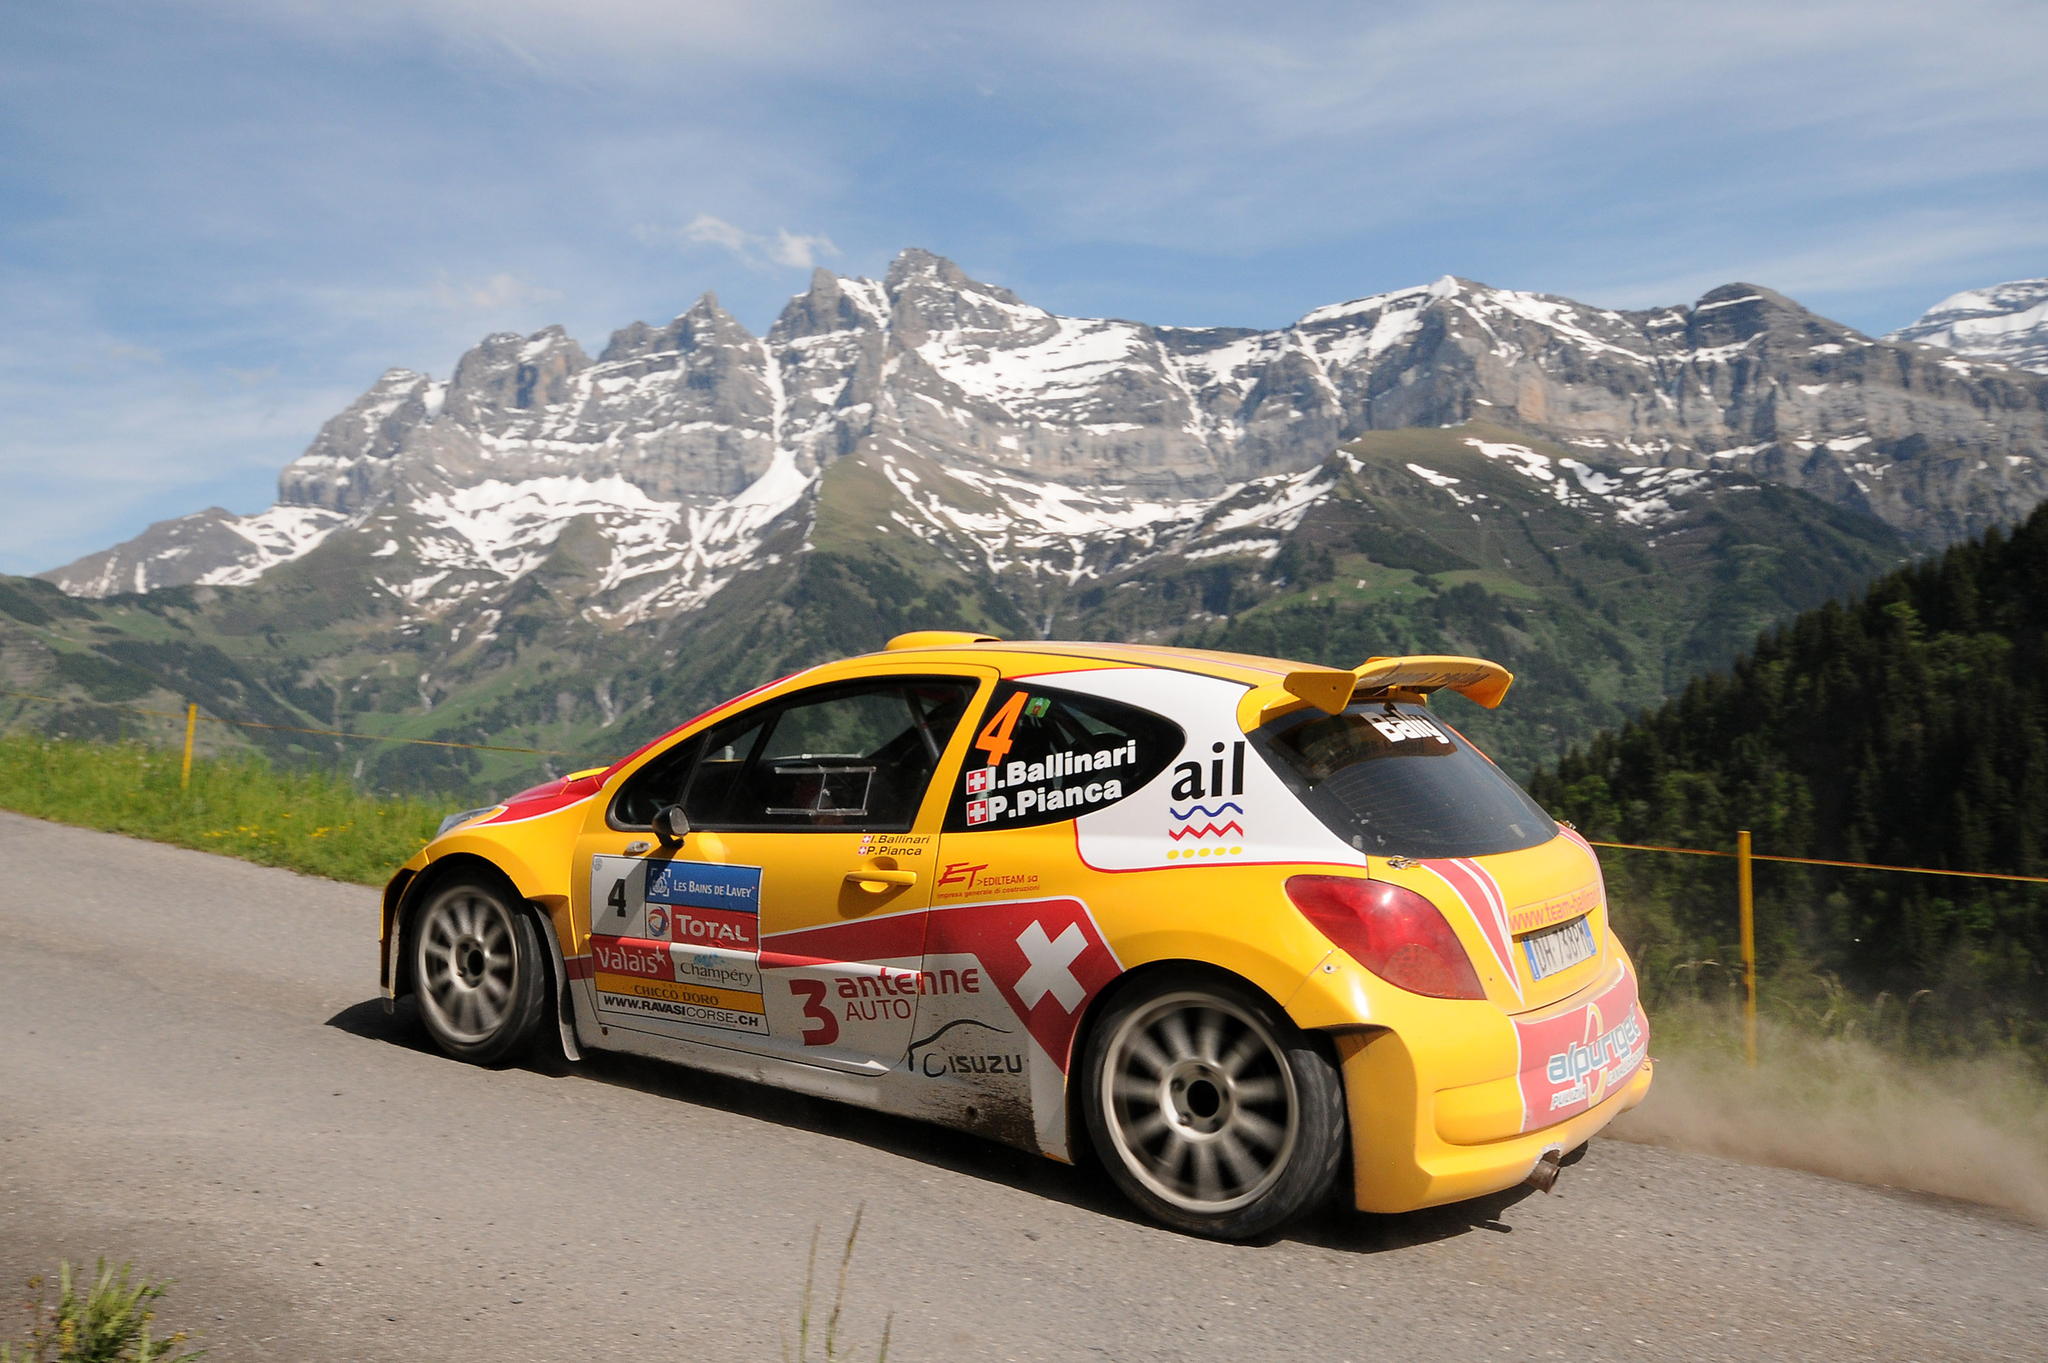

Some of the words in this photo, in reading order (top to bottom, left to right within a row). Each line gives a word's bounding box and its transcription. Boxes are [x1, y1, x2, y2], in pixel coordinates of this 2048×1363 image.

[975, 692, 1029, 766] 4
[1360, 709, 1450, 744] Bally
[988, 740, 1137, 791] I.Ballinari
[1170, 741, 1246, 801] ail
[988, 780, 1122, 822] P.Pianca
[866, 846, 922, 855] P.Pianca
[870, 835, 931, 844] I.Ballinari
[938, 862, 989, 890] ET
[1027, 875, 1038, 883] sa
[608, 879, 627, 917] 4
[964, 888, 993, 898] generale
[1002, 885, 1040, 894] costruzioni
[596, 947, 659, 974] Valais
[680, 962, 753, 987] Champéry
[634, 984, 679, 1000] CHICCO
[603, 995, 759, 1027] WWW.RAVASICORSE.CH
[788, 979, 840, 1046] 3
[845, 999, 912, 1021] AUTO
